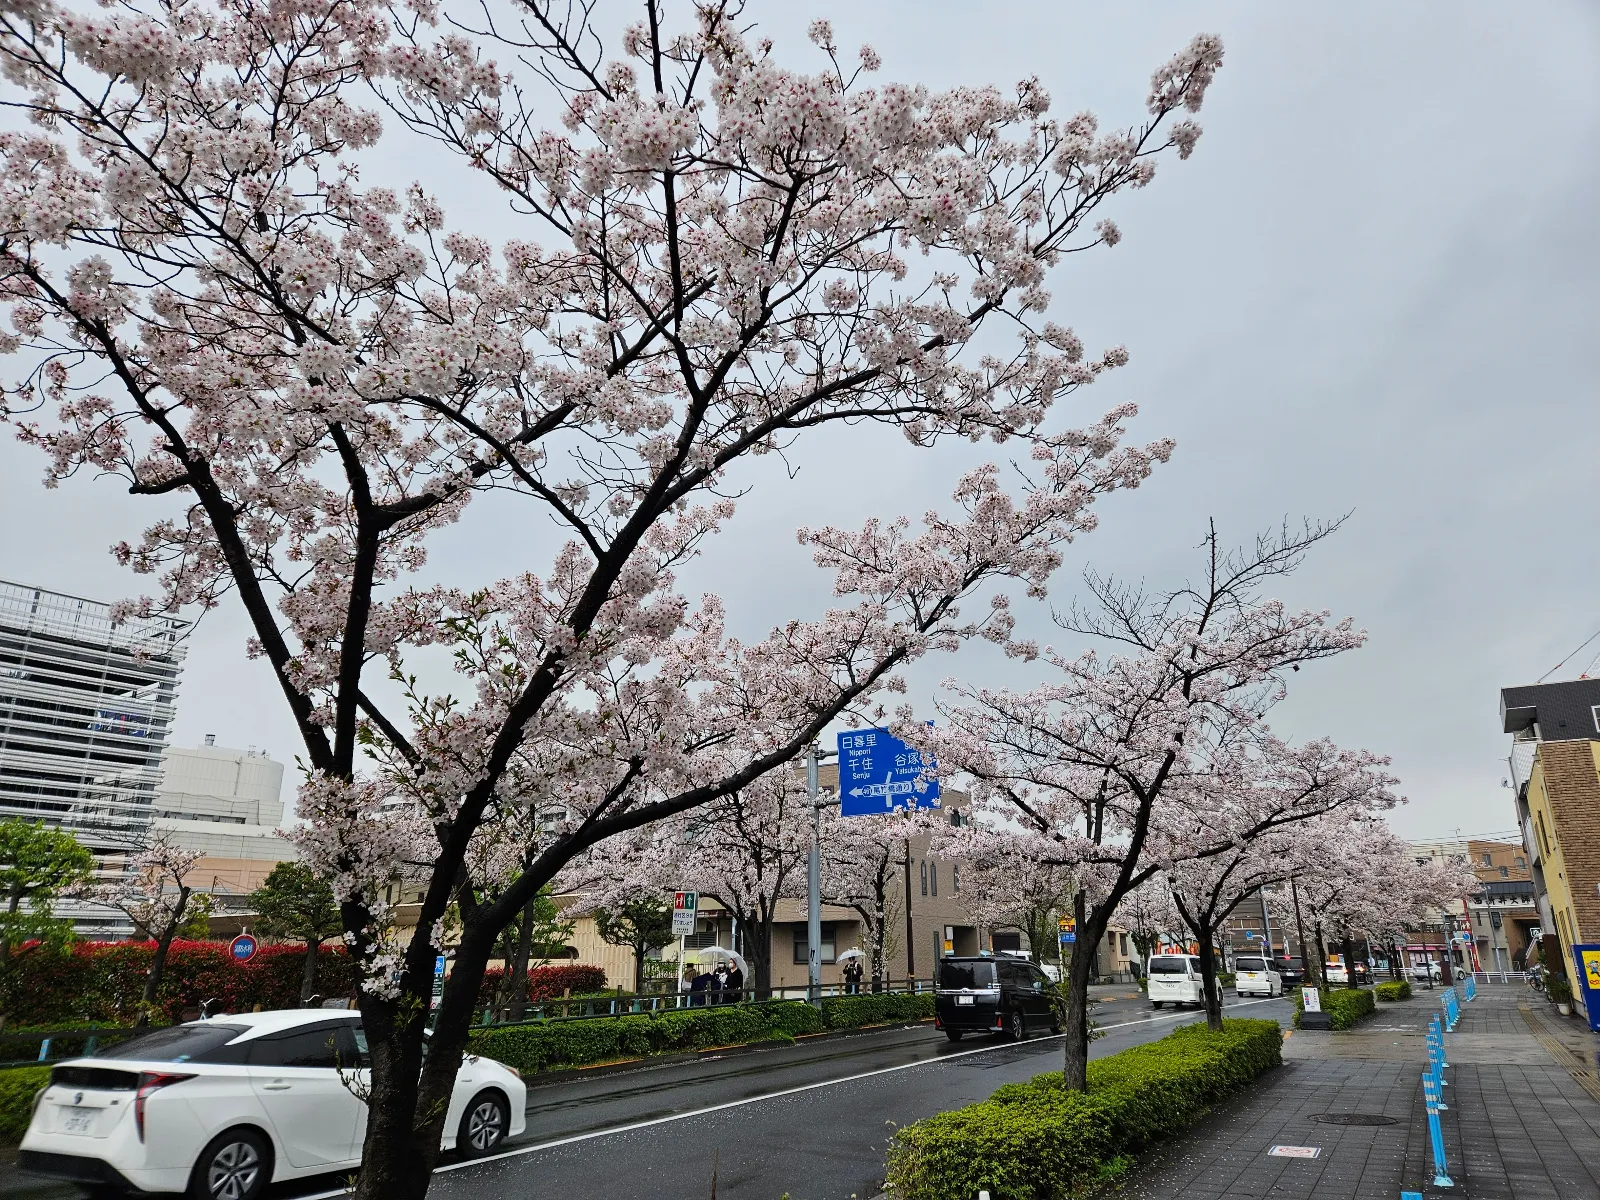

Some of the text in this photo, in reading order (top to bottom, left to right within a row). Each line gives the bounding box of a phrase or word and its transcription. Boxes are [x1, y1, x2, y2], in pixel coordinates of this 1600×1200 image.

[842, 733, 878, 749] 日暮里
[848, 747, 871, 757] Nippori
[848, 757, 873, 771] 千住
[852, 771, 871, 780] Senju
